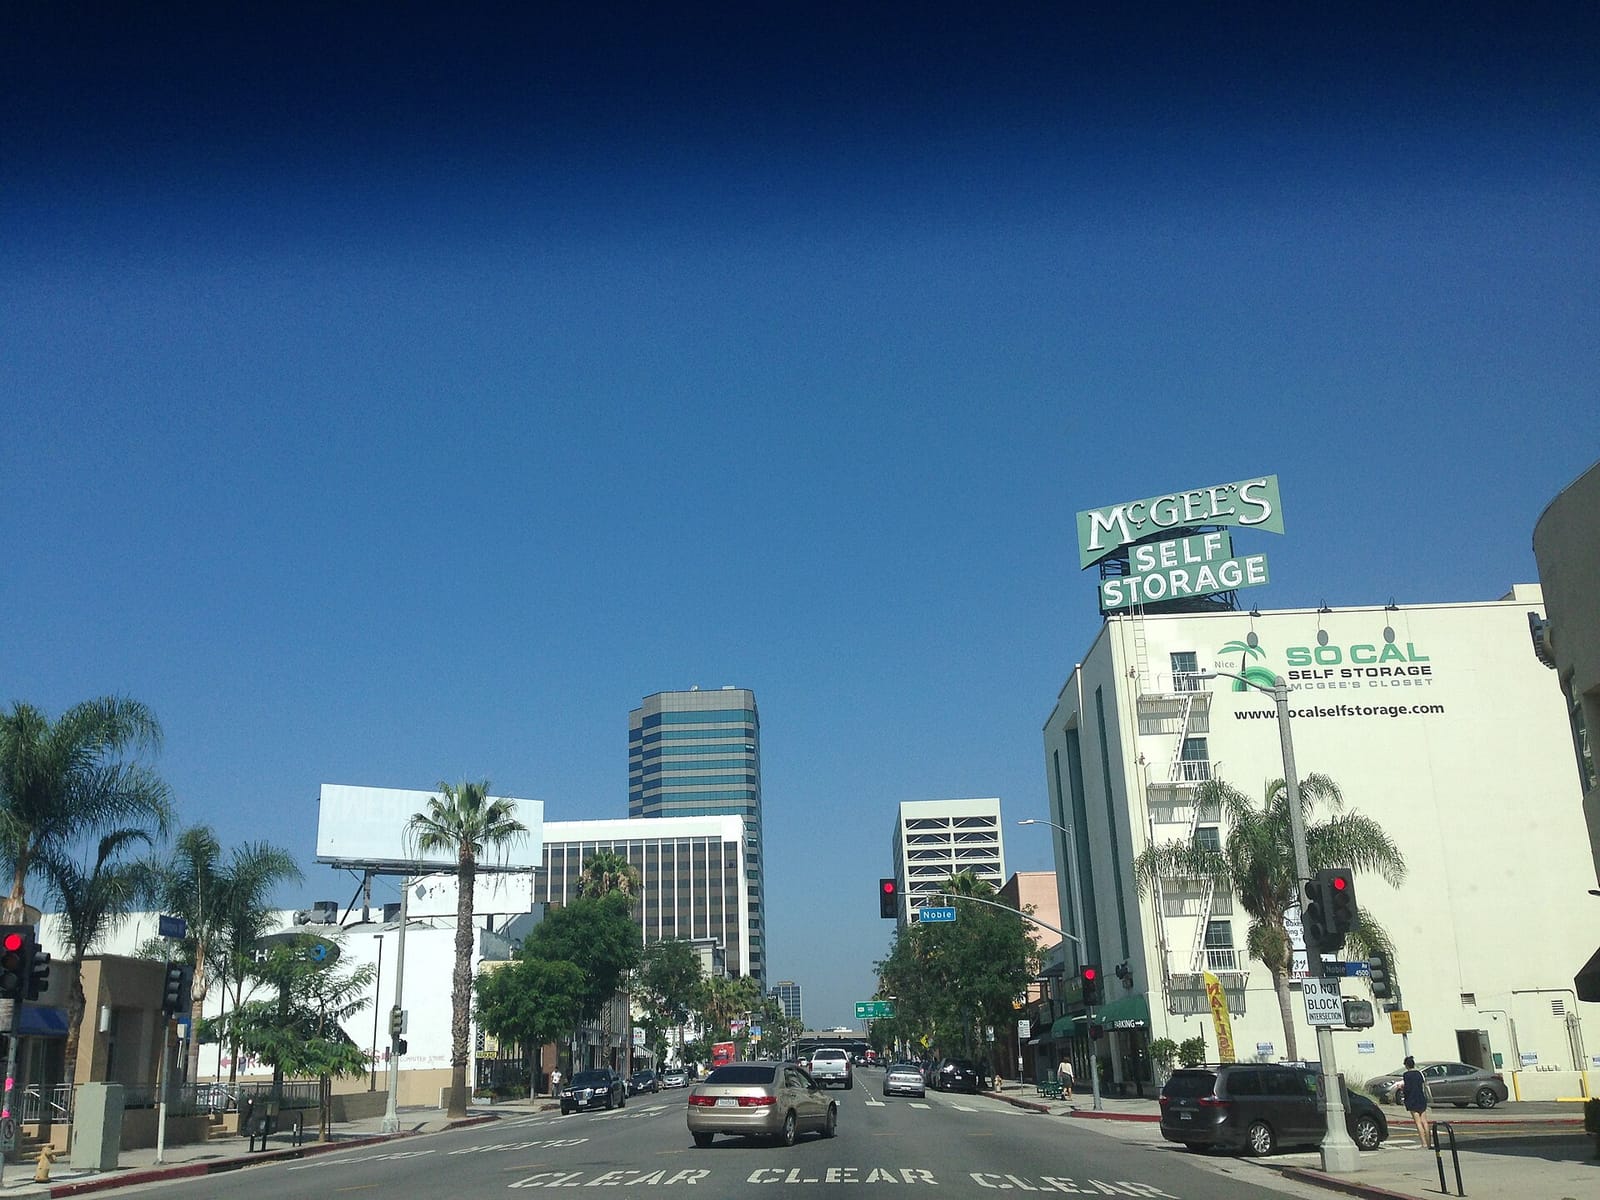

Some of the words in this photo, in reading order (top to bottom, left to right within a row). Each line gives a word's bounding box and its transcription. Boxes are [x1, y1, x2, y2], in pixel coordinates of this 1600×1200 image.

[1136, 532, 1222, 572] SELF
[1104, 556, 1267, 606] STORAGE
[1286, 646, 1342, 667] SO
[1350, 643, 1430, 664] CAL
[1214, 660, 1238, 669] Nice.
[1288, 668, 1335, 680] SELF
[1341, 665, 1433, 678] STORAGE
[1290, 681, 1361, 690] MCGEE'S
[1369, 678, 1433, 688] CLOSET
[1234, 704, 1445, 720] www.ocalselfstorage.com
[923, 911, 952, 919] Noble
[1304, 984, 1317, 994] DO
[1320, 983, 1337, 994] NOT
[1308, 999, 1339, 1010] BLOCK
[1309, 1012, 1342, 1021] INTERSECTION
[1114, 1019, 1135, 1028] PARKING
[507, 1168, 714, 1188] CLEAR
[746, 1167, 939, 1185] CLEAR
[969, 1172, 1181, 1200] CLEAR
